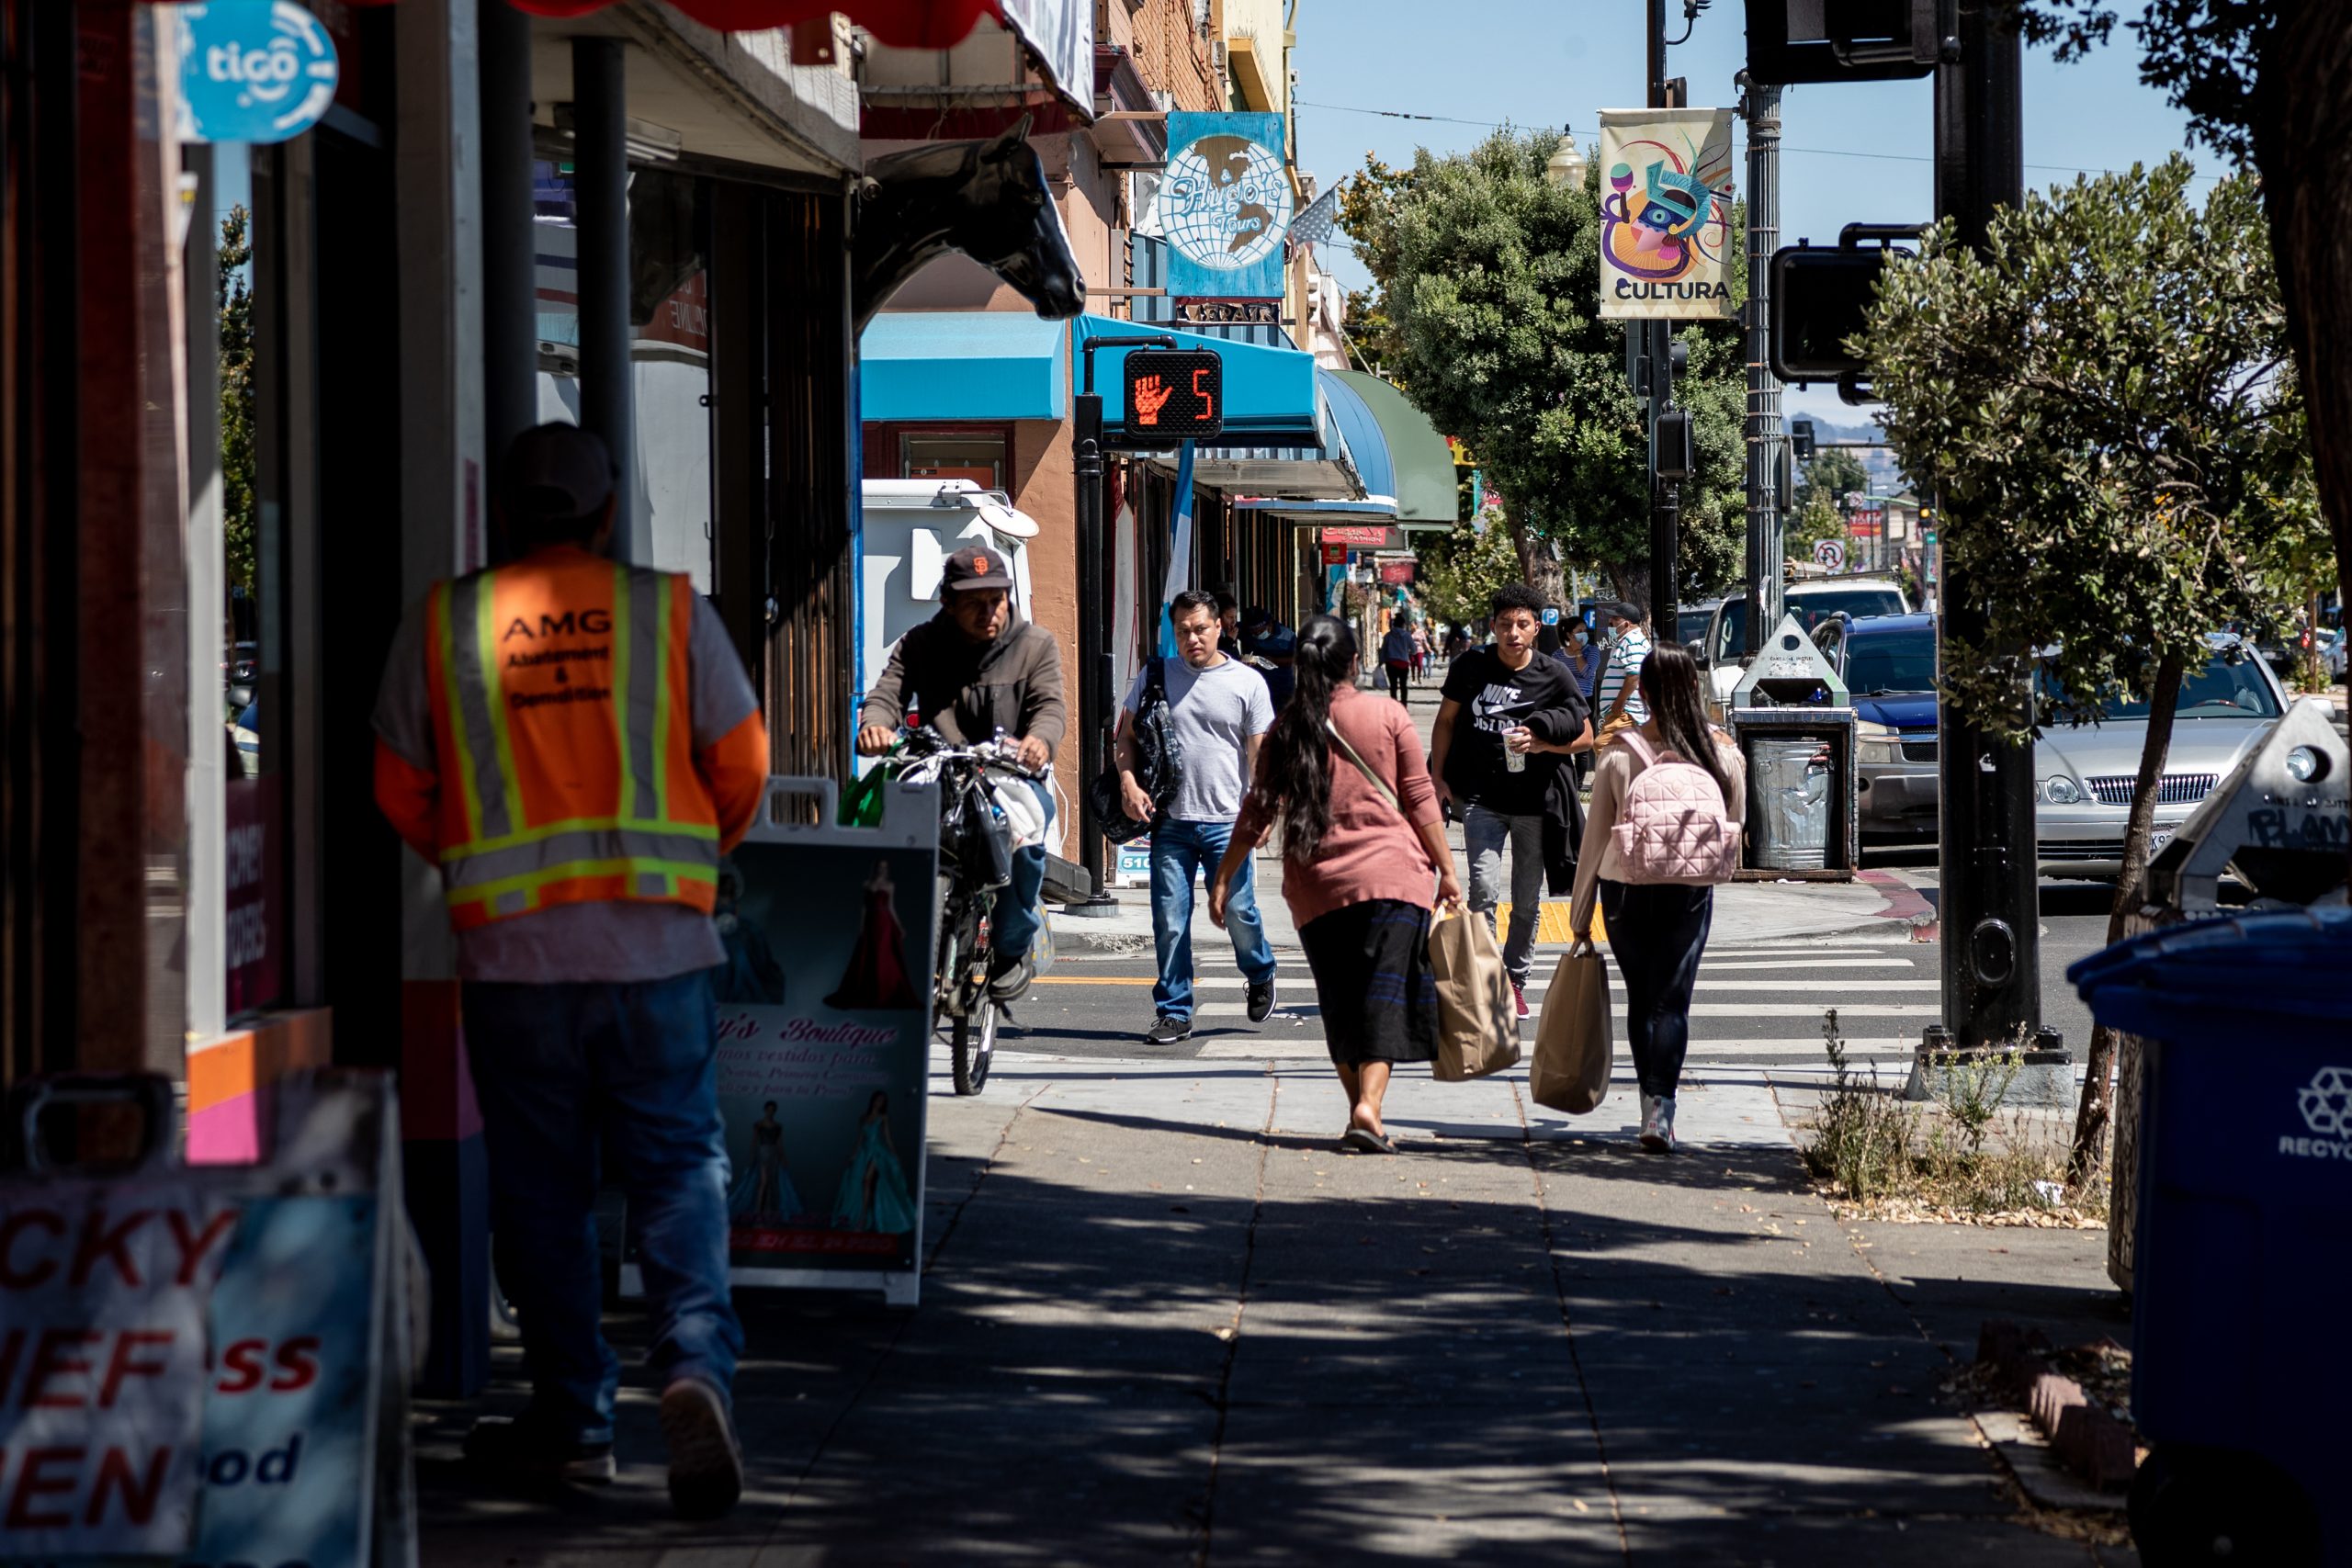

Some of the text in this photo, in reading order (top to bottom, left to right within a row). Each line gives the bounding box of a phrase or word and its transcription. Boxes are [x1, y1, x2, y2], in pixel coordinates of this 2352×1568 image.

[207, 37, 300, 103] tigo
[1169, 172, 1284, 217] Hugo's
[1212, 213, 1262, 233] Tours
[1615, 280, 1730, 300] CULTURA
[1193, 369, 1212, 419] 5
[503, 610, 611, 642] AMG
[1482, 682, 1522, 705] NIKE
[779, 1017, 897, 1050] Boutique
[204, 1337, 322, 1394] ss
[198, 1433, 303, 1488] od
[0, 1446, 171, 1529] EN
